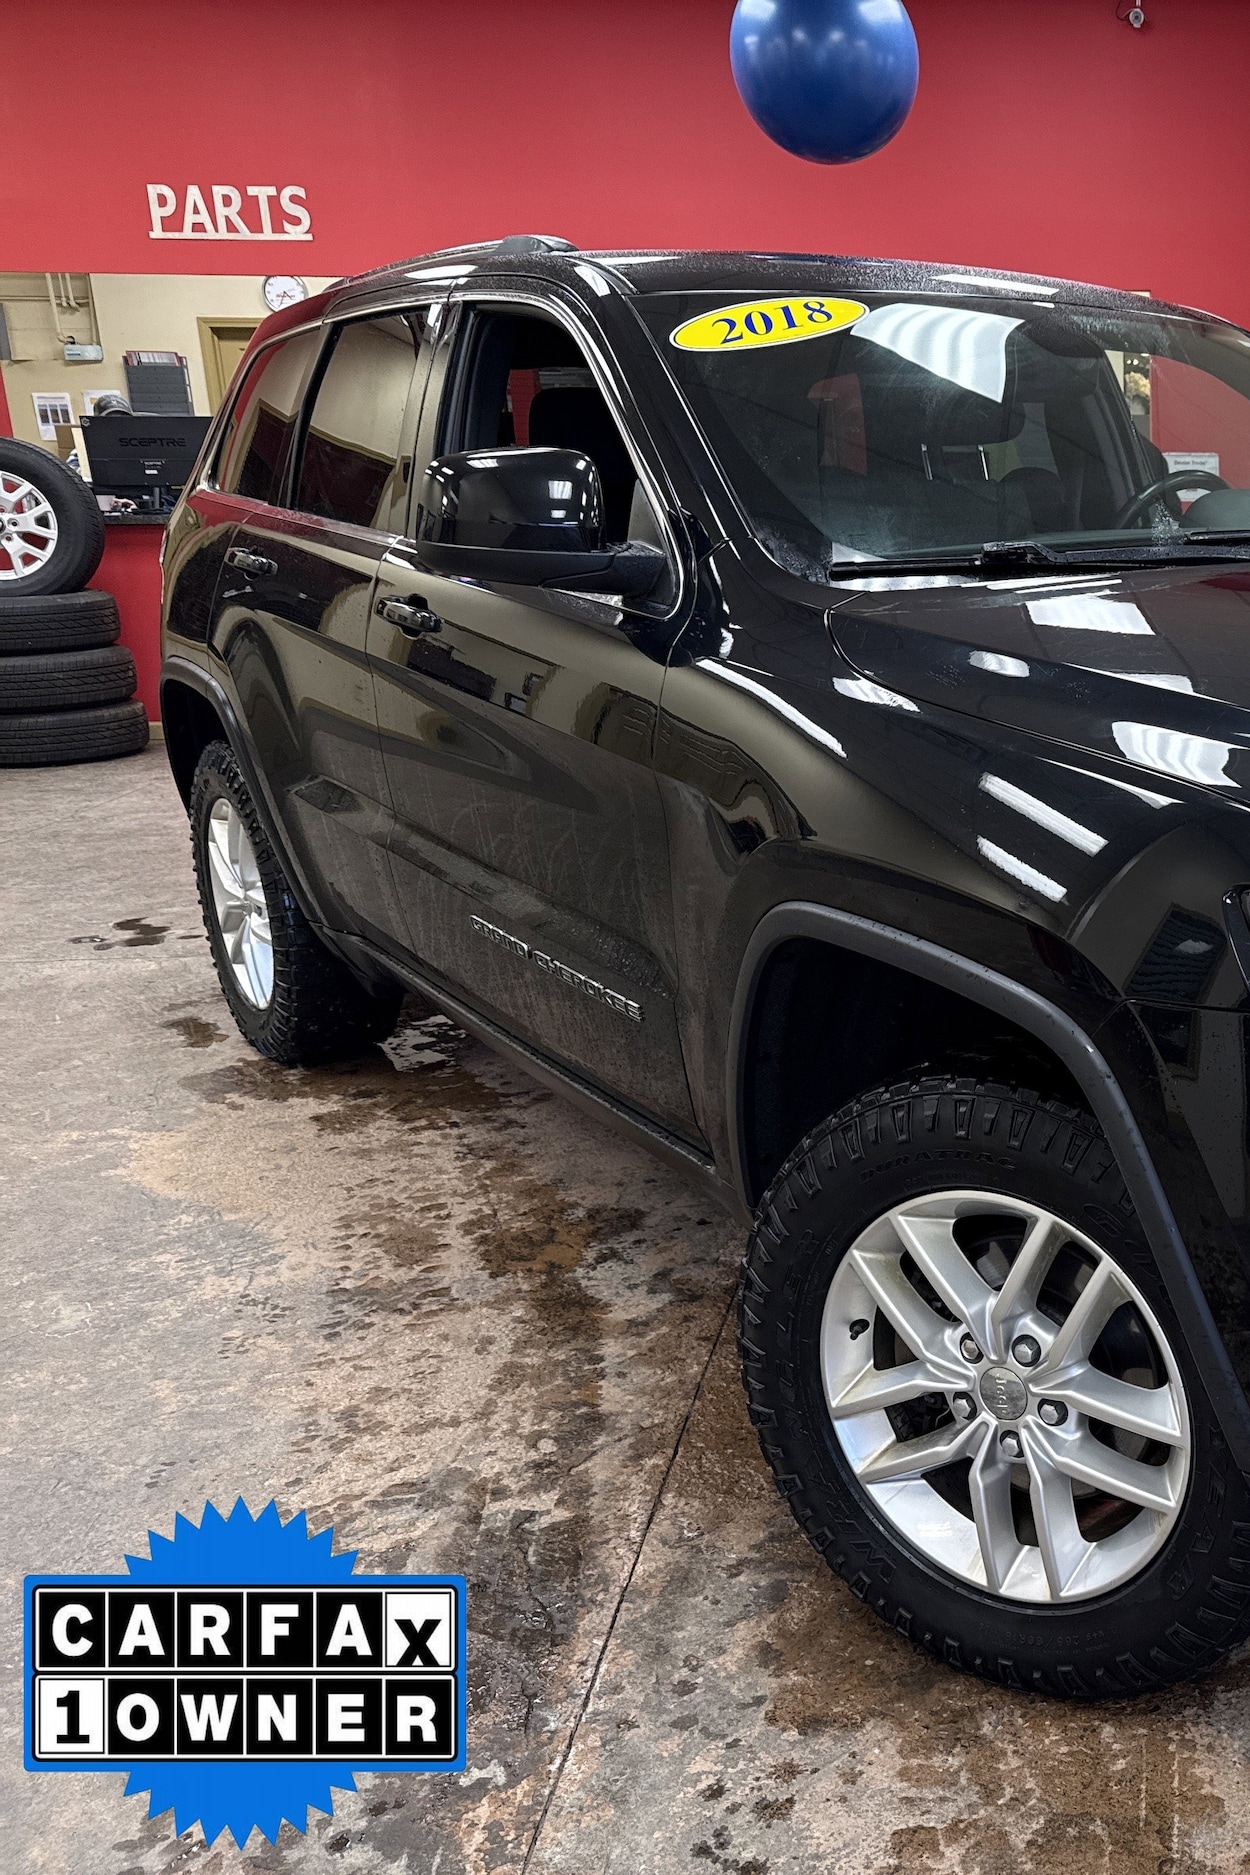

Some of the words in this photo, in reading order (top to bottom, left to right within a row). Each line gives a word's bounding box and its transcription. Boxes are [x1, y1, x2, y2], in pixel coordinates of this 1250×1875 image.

[147, 184, 312, 238] PARTS
[712, 301, 833, 344] 2018
[119, 437, 186, 447] SCEPTRE
[469, 914, 531, 960] GRAND
[533, 950, 644, 1022] CHEROKEE
[859, 1149, 1017, 1182] DURATRAC
[995, 1373, 1010, 1414] Jeep
